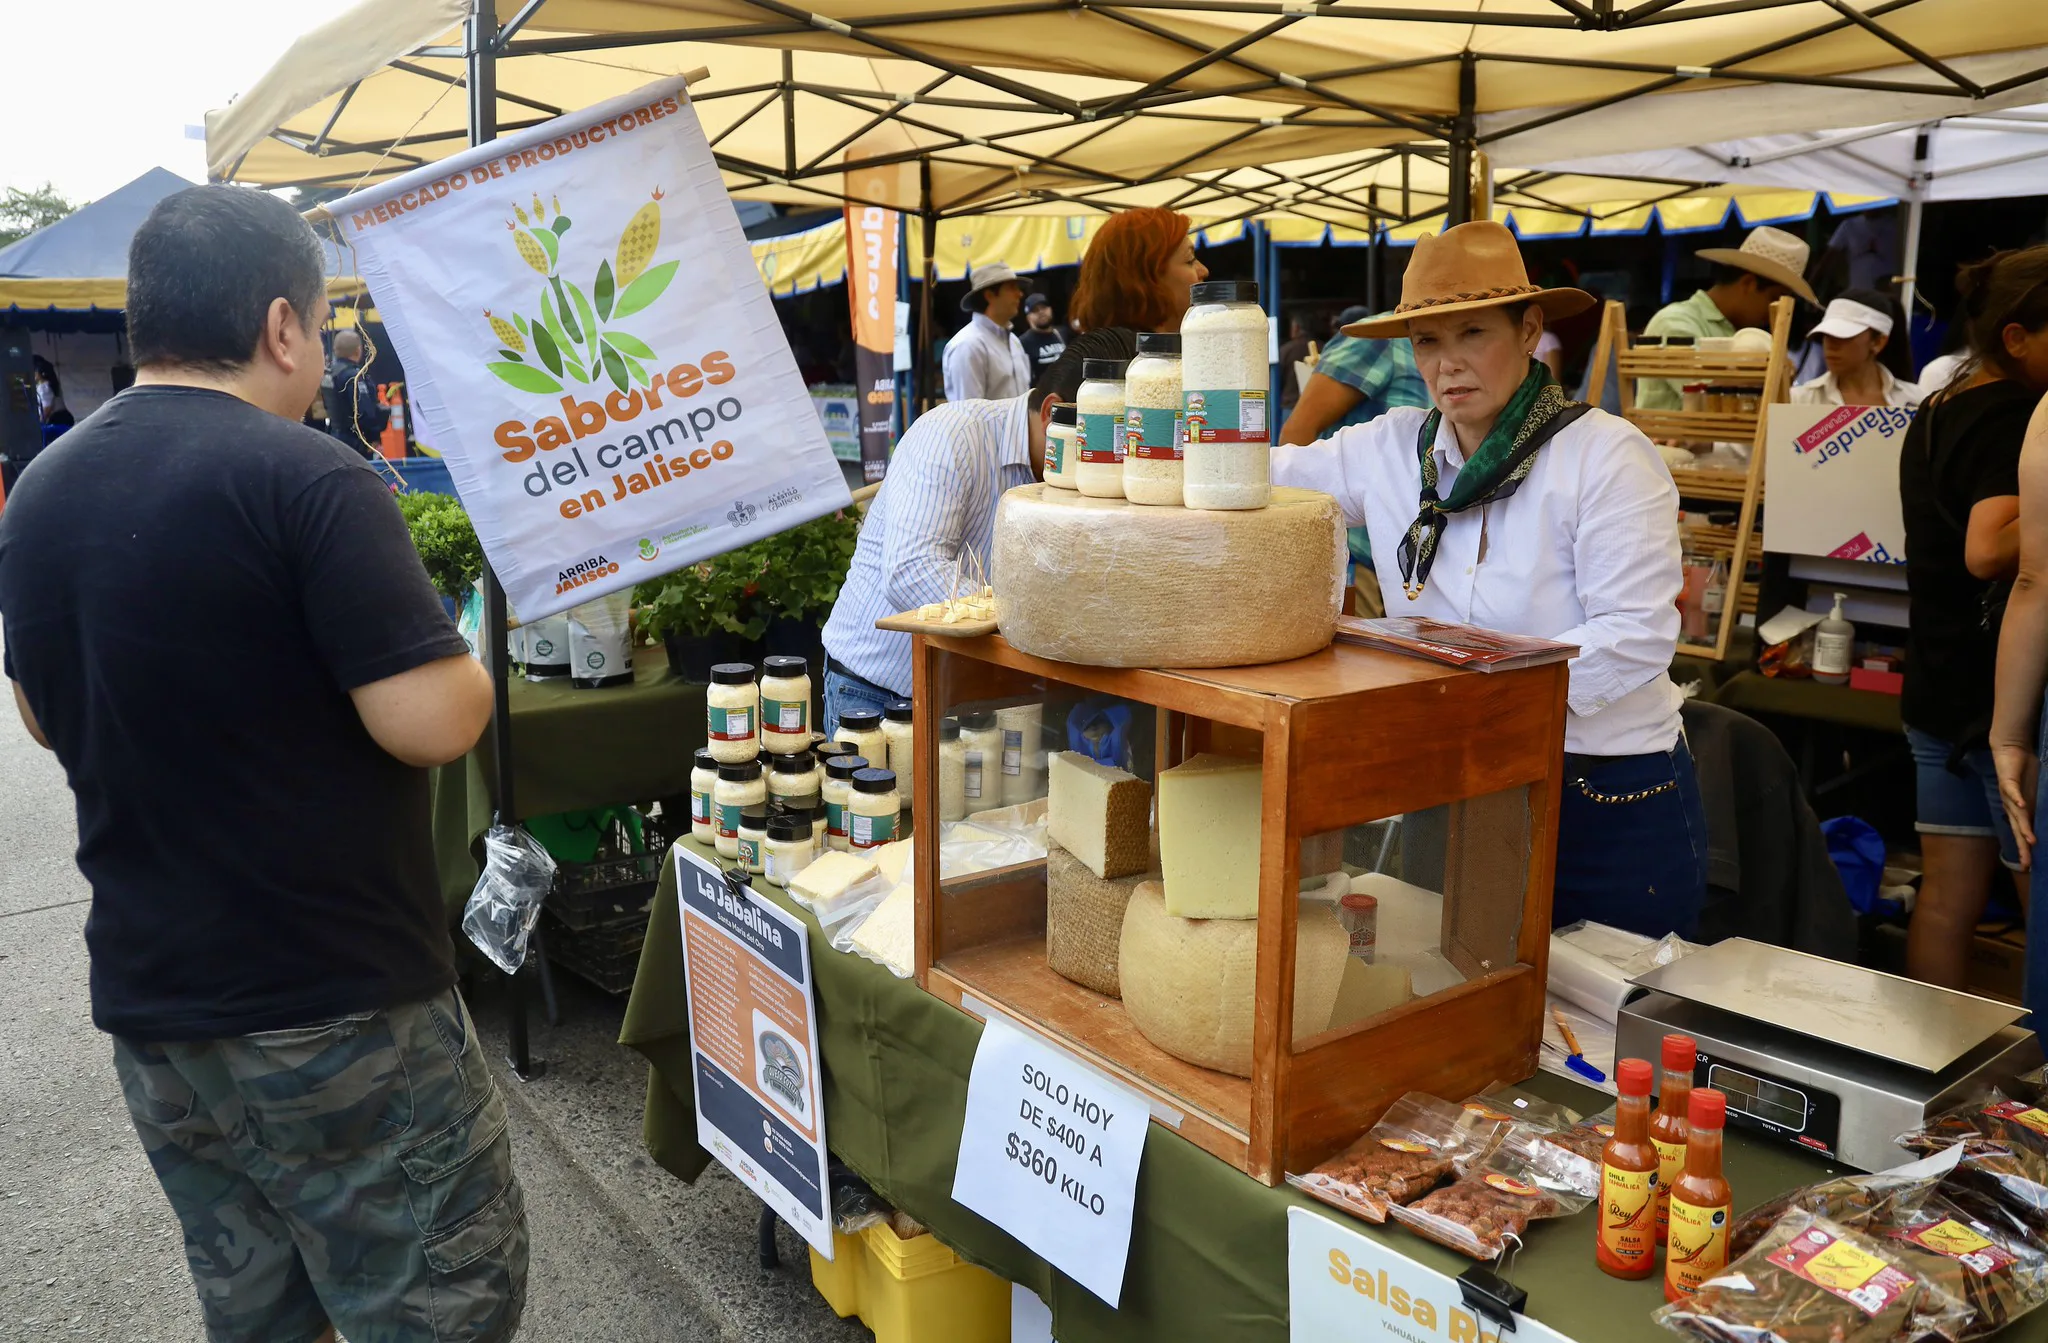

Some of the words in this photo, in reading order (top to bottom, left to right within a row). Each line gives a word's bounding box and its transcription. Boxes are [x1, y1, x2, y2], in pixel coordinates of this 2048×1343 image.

[352, 174, 468, 232] MERCADO
[471, 161, 505, 191] DE
[505, 96, 679, 176] PRODUCTORES
[493, 350, 736, 463] Sabores
[1806, 408, 1852, 444] ESPUMADO
[523, 447, 590, 497] del
[596, 396, 743, 470] campo
[559, 488, 607, 519] en
[612, 439, 734, 501] Jalisco
[555, 561, 620, 596] JALISCO
[558, 555, 608, 582] ARRIBA
[696, 871, 716, 903] La
[716, 884, 783, 950] Jabalina
[717, 912, 731, 927] Santa
[746, 933, 755, 944] del
[755, 938, 765, 951] Oro
[1022, 1063, 1069, 1106] SOLO
[1073, 1093, 1115, 1131] HOY
[1020, 1099, 1044, 1129] DE
[1046, 1116, 1086, 1155] $400
[1089, 1145, 1103, 1168] A
[1761, 1123, 1777, 1132] TOTAL
[1005, 1131, 1058, 1185] $360
[1060, 1173, 1106, 1216] KILO
[1608, 1172, 1625, 1182] CHILE
[1609, 1202, 1632, 1221] Rey
[1672, 1203, 1686, 1215] CHILE
[1620, 1235, 1641, 1243] SALSA
[1672, 1235, 1692, 1257] Rey
[1680, 1271, 1703, 1282] SALSA
[1692, 1255, 1715, 1270] Rojo
[1328, 1248, 1438, 1333] Salsa
